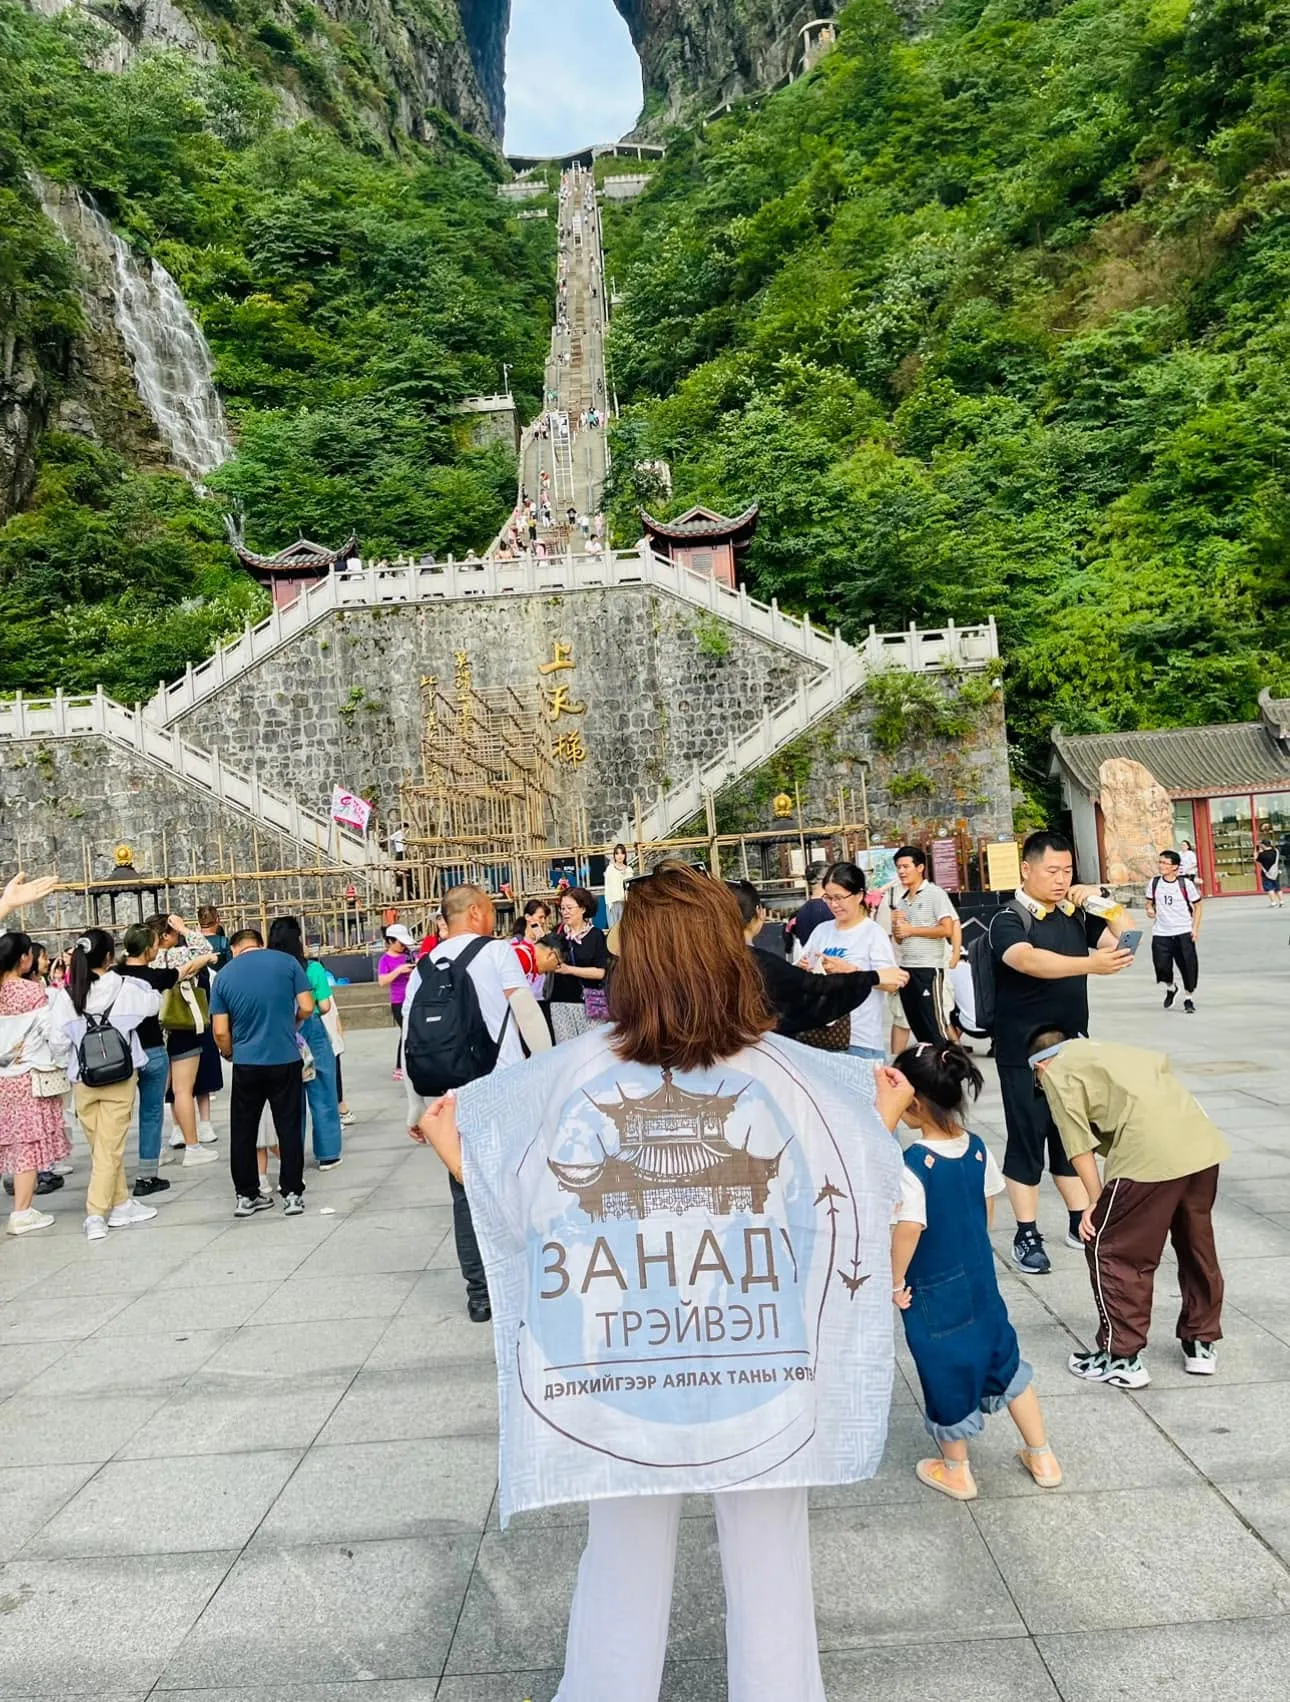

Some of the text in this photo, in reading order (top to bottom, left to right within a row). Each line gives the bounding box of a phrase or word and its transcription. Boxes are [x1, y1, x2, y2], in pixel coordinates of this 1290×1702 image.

[537, 642, 587, 769] 上天梯
[1163, 895, 1173, 906] 13
[595, 1299, 780, 1348] ТРЭЙВЭЛ
[543, 1373, 657, 1401] ДЭЛХИЙГЭЭР
[663, 1371, 722, 1388] АЯЛАХ
[727, 1368, 777, 1385] ТАНЫ
